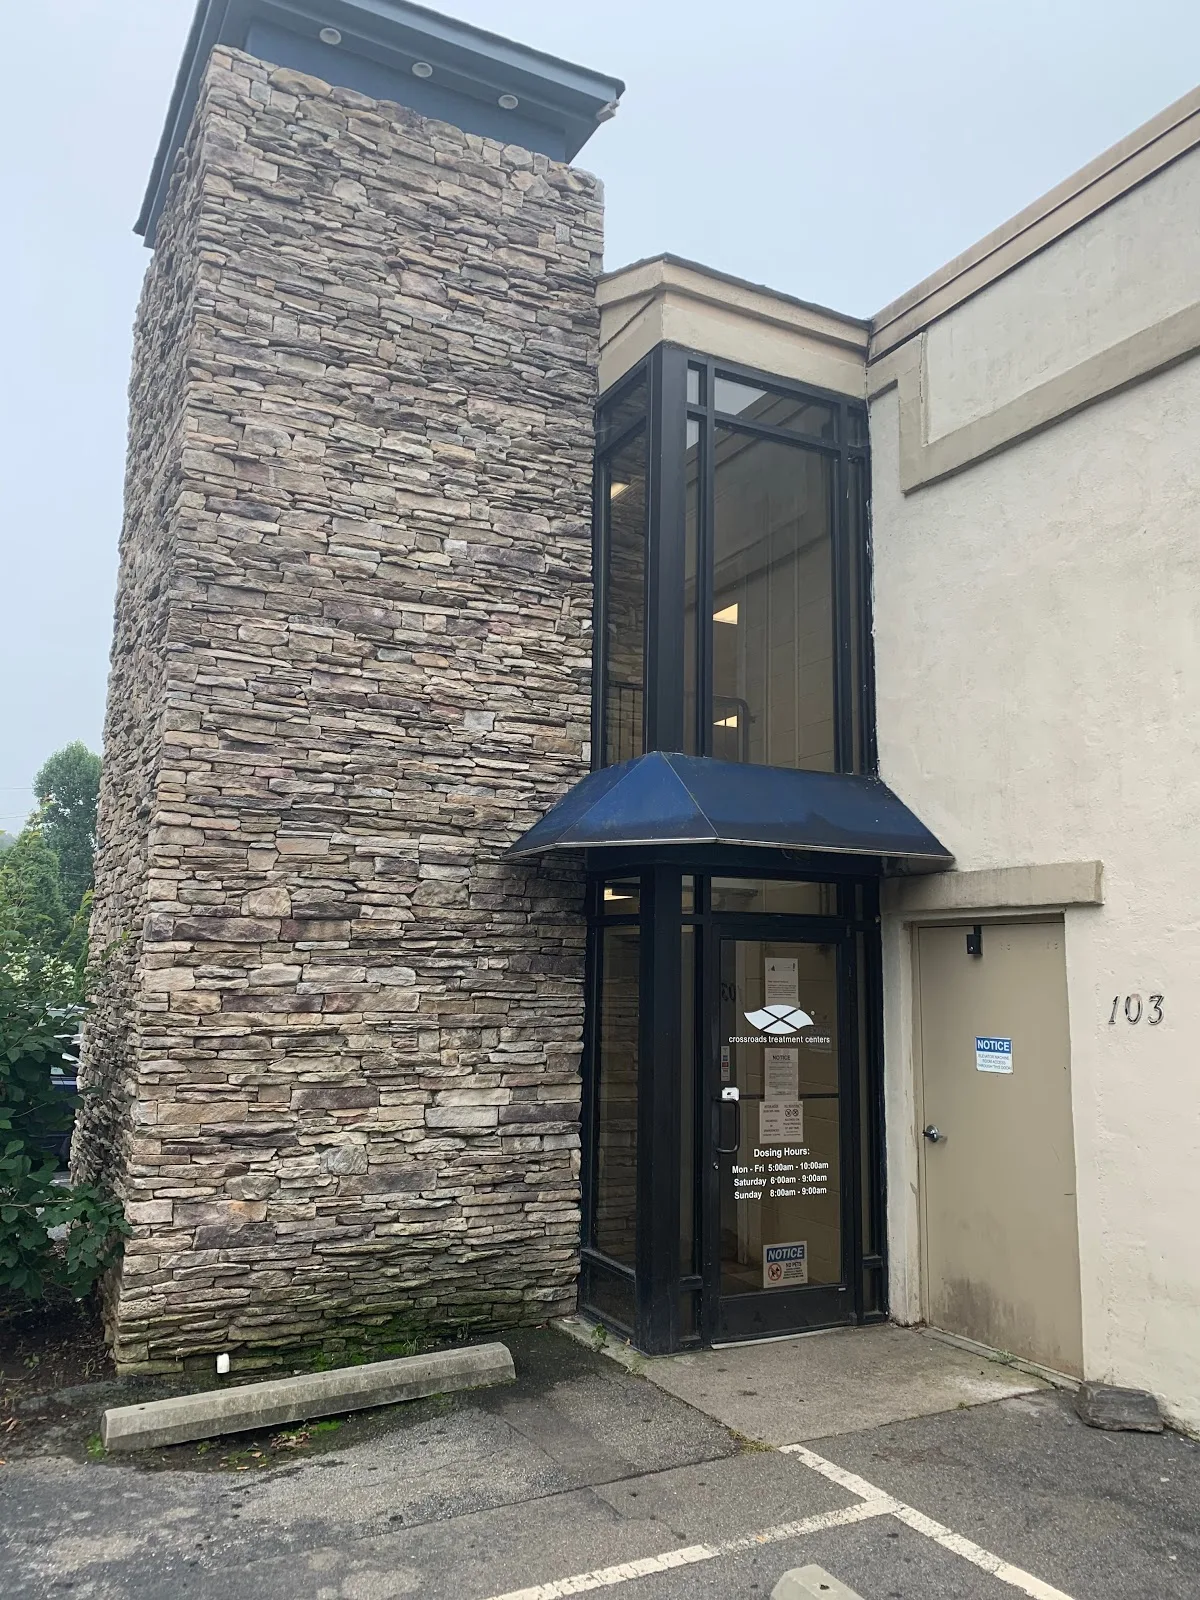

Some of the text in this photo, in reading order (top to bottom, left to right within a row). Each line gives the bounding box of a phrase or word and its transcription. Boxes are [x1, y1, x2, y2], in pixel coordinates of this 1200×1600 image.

[1108, 994, 1164, 1025] 103
[728, 1035, 767, 1043] crossroads
[768, 1035, 803, 1043] treatment
[977, 1039, 1010, 1051] NOTICE
[753, 1147, 810, 1158] Dosing Hours:
[732, 1165, 748, 1173] Mon
[754, 1164, 765, 1172] Fri
[768, 1163, 794, 1172] 5:00am
[800, 1161, 829, 1170] 10:00am
[733, 1178, 767, 1187] Saturday
[770, 1176, 796, 1184] 6:00am
[802, 1174, 827, 1182] 9:00am
[734, 1191, 762, 1200] Sunday
[770, 1189, 796, 1197] 8:00am
[802, 1187, 827, 1195] 9:00am
[768, 1247, 803, 1260] NOTICE
